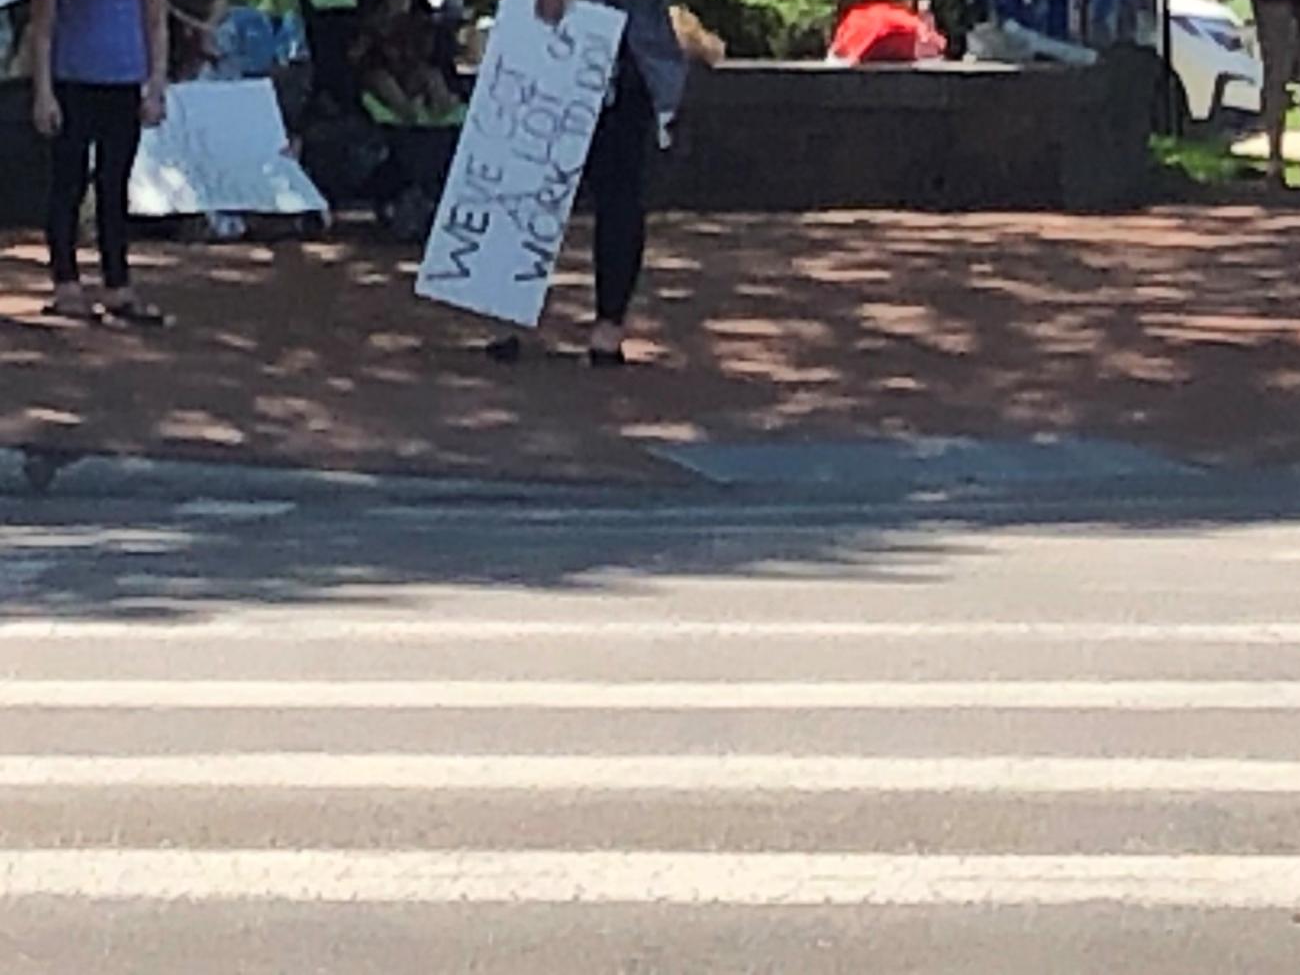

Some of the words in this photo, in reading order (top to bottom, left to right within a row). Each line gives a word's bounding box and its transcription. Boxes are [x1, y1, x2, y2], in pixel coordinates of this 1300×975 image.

[510, 79, 562, 166] LOT
[495, 189, 540, 231] A
[514, 161, 585, 283] WORK
